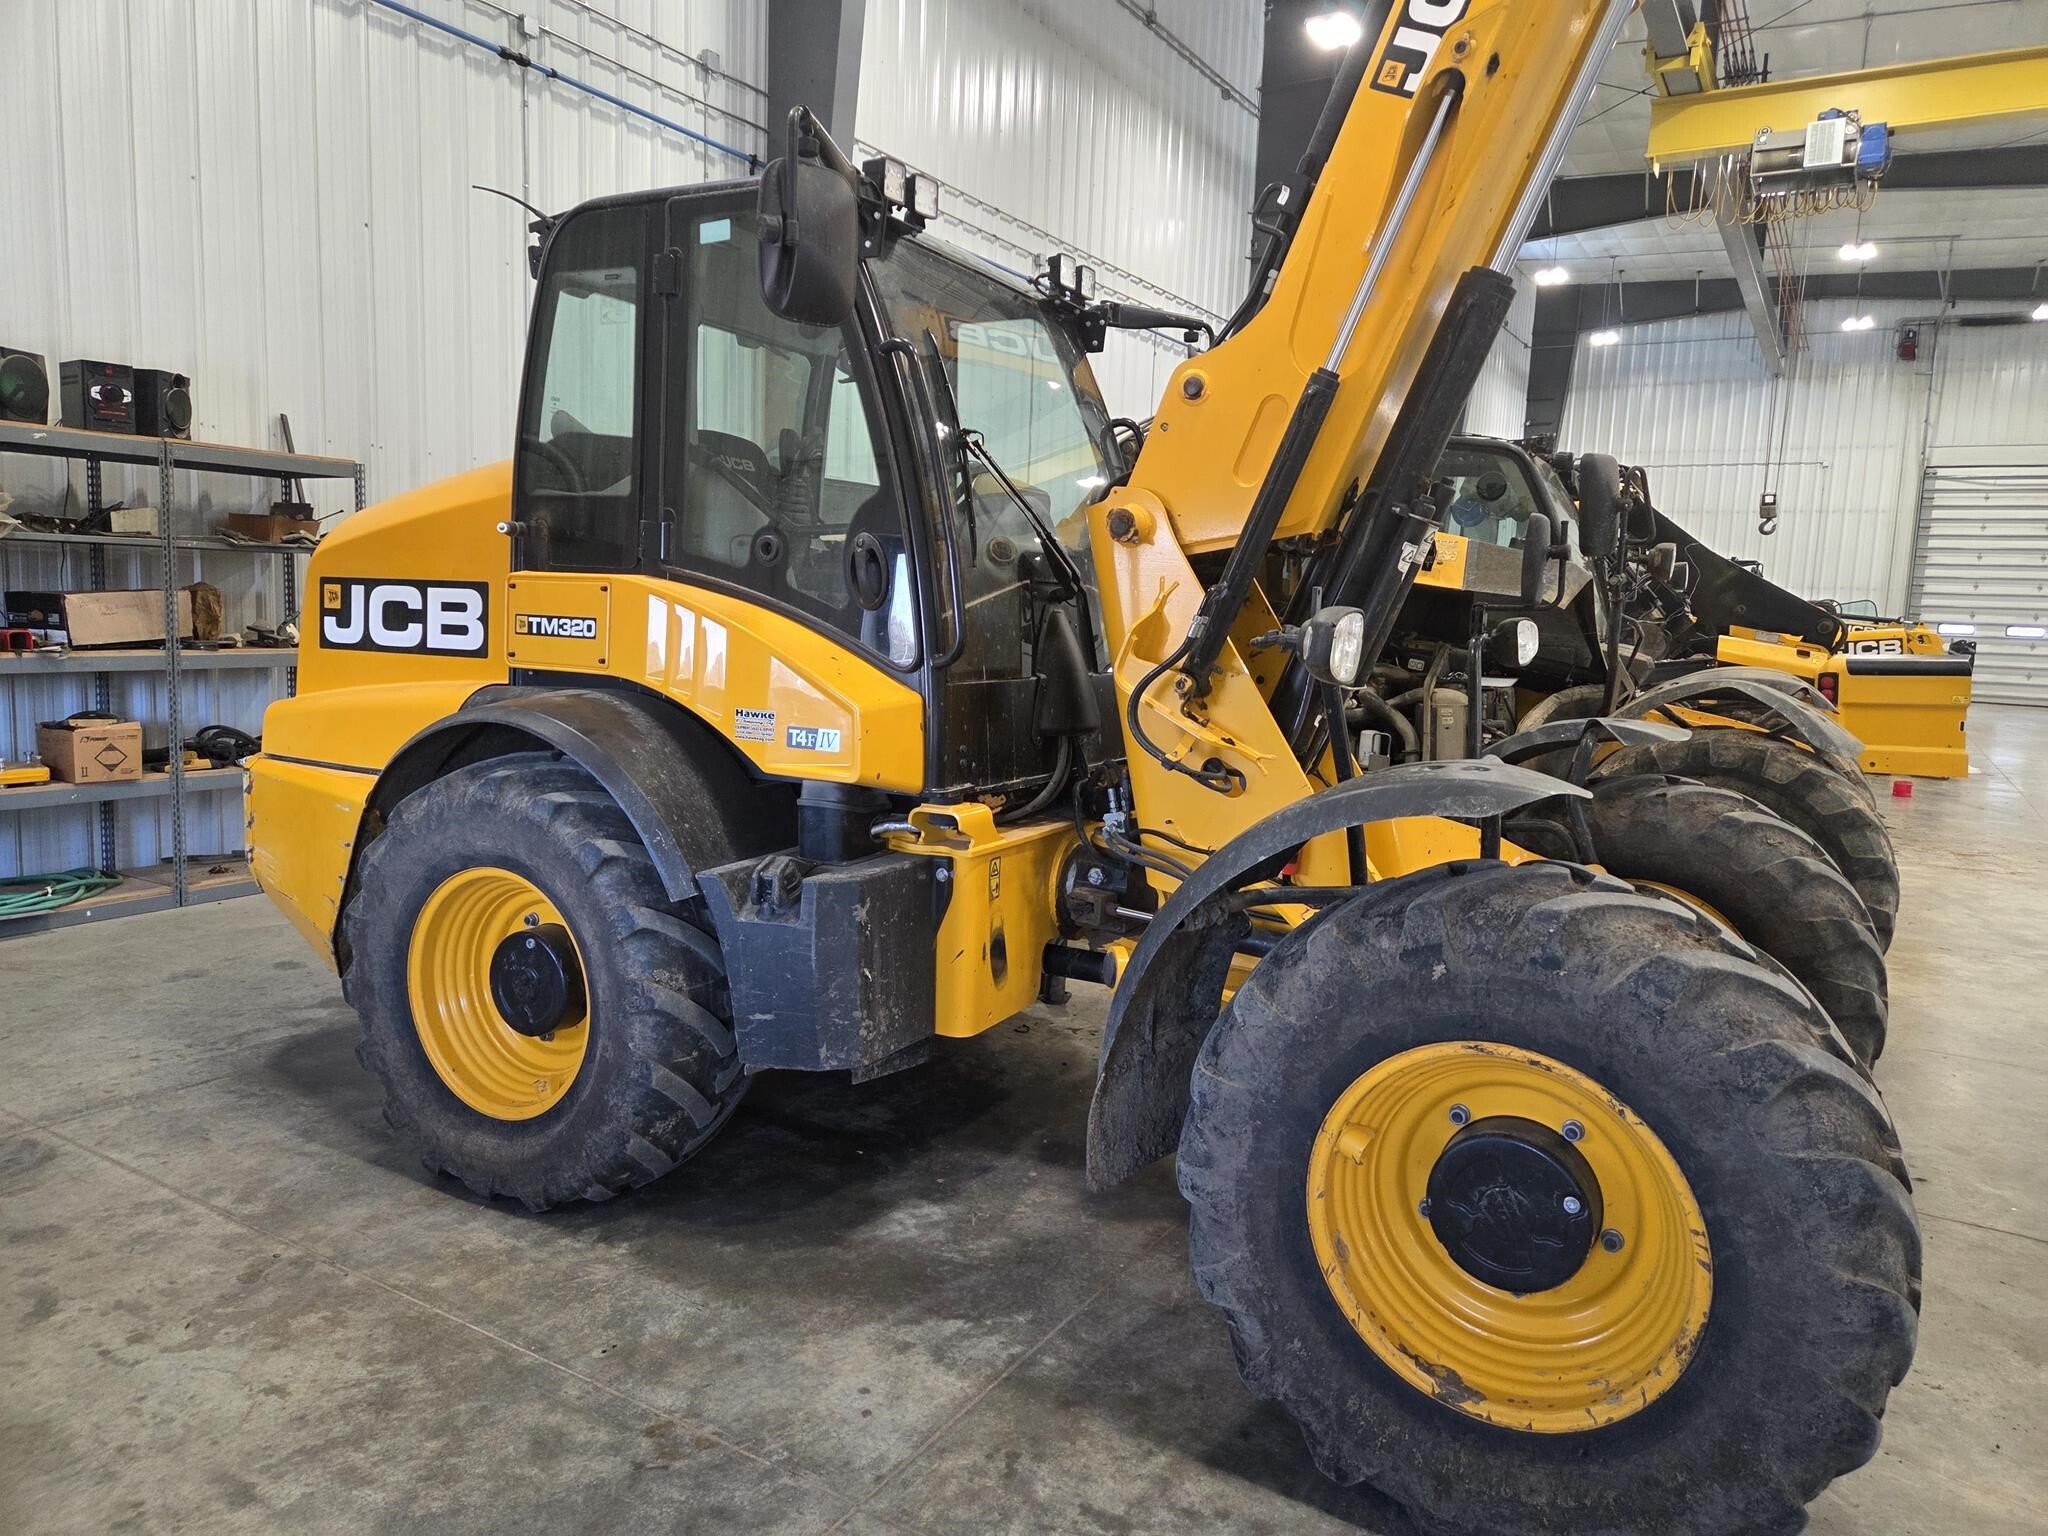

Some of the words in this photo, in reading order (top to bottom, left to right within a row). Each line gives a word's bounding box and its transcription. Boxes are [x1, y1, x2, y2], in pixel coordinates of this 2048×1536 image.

[720, 455, 756, 472] JCB
[324, 584, 485, 650] JCB
[528, 616, 596, 638] TM320
[1838, 639, 1902, 655] JCB
[735, 708, 775, 720] Hawke
